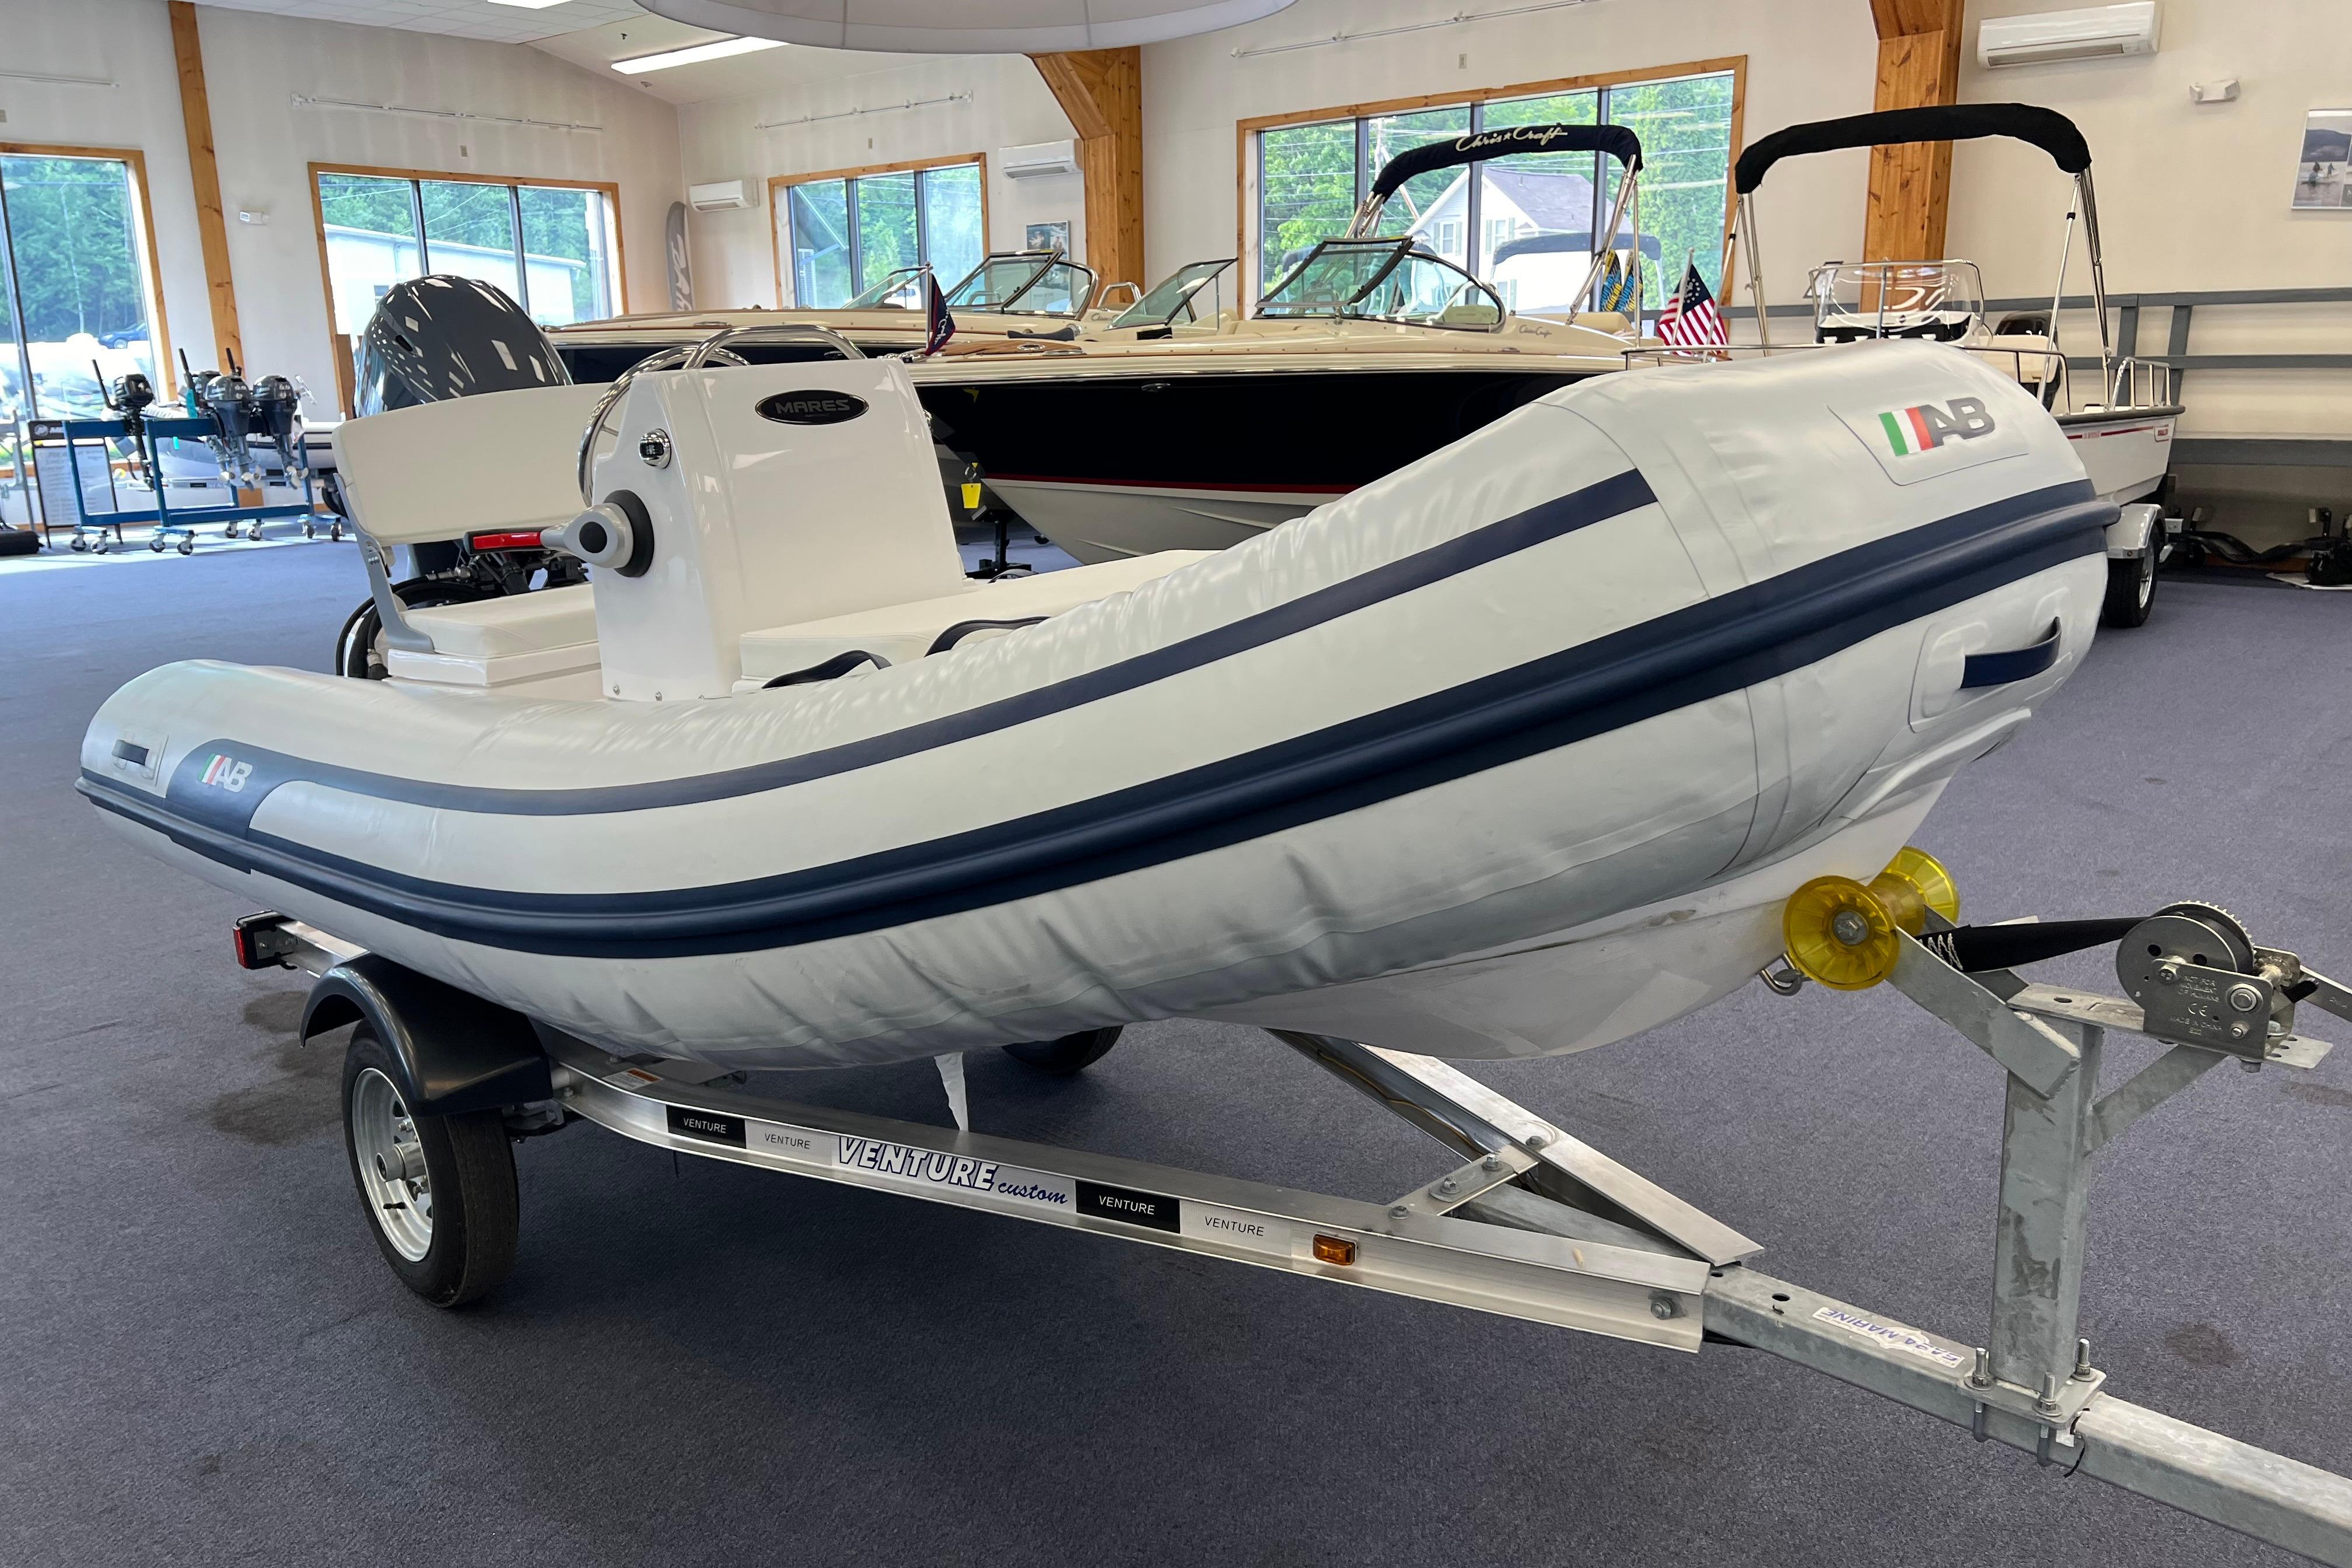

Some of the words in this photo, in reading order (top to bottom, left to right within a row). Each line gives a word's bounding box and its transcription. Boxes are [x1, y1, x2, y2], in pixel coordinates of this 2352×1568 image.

[1513, 127, 1568, 146] Craft
[775, 400, 850, 414] MARES
[1917, 397, 1996, 448] AB
[211, 757, 253, 793] AB
[683, 1117, 727, 1134] VENTURE
[764, 1133, 811, 1150] VENTURE
[839, 1136, 1000, 1192] VENTURE
[998, 1181, 1069, 1205] custom
[1098, 1195, 1156, 1216] VENTURE
[1205, 1216, 1265, 1237] VENTURE
[1825, 1308, 1898, 1339] MARINE
